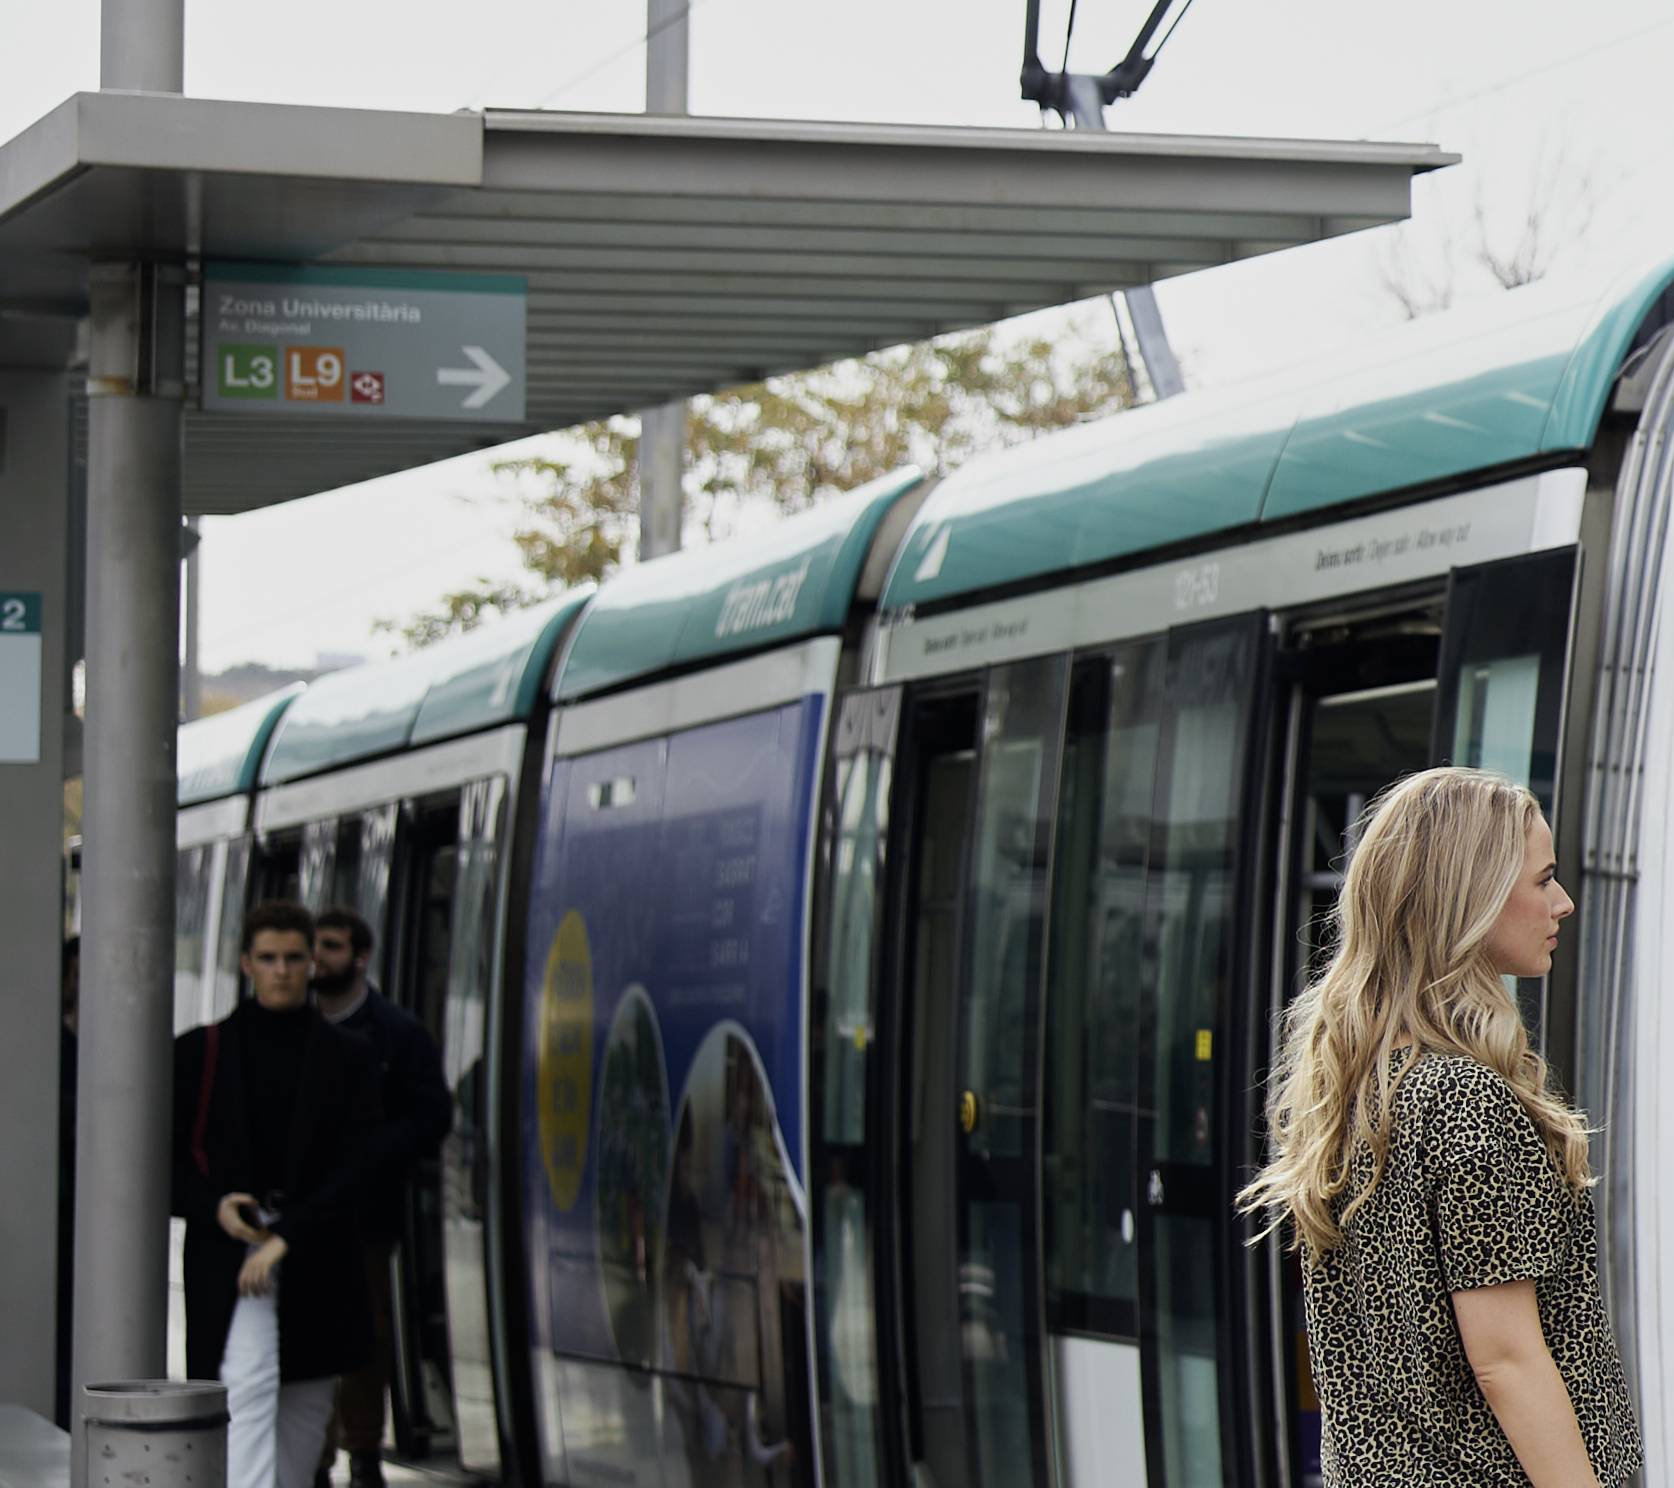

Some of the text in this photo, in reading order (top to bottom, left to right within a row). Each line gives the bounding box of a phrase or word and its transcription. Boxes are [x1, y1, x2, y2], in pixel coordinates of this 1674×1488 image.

[219, 295, 422, 323] Zona Universitària
[223, 352, 342, 388] L3 L9
